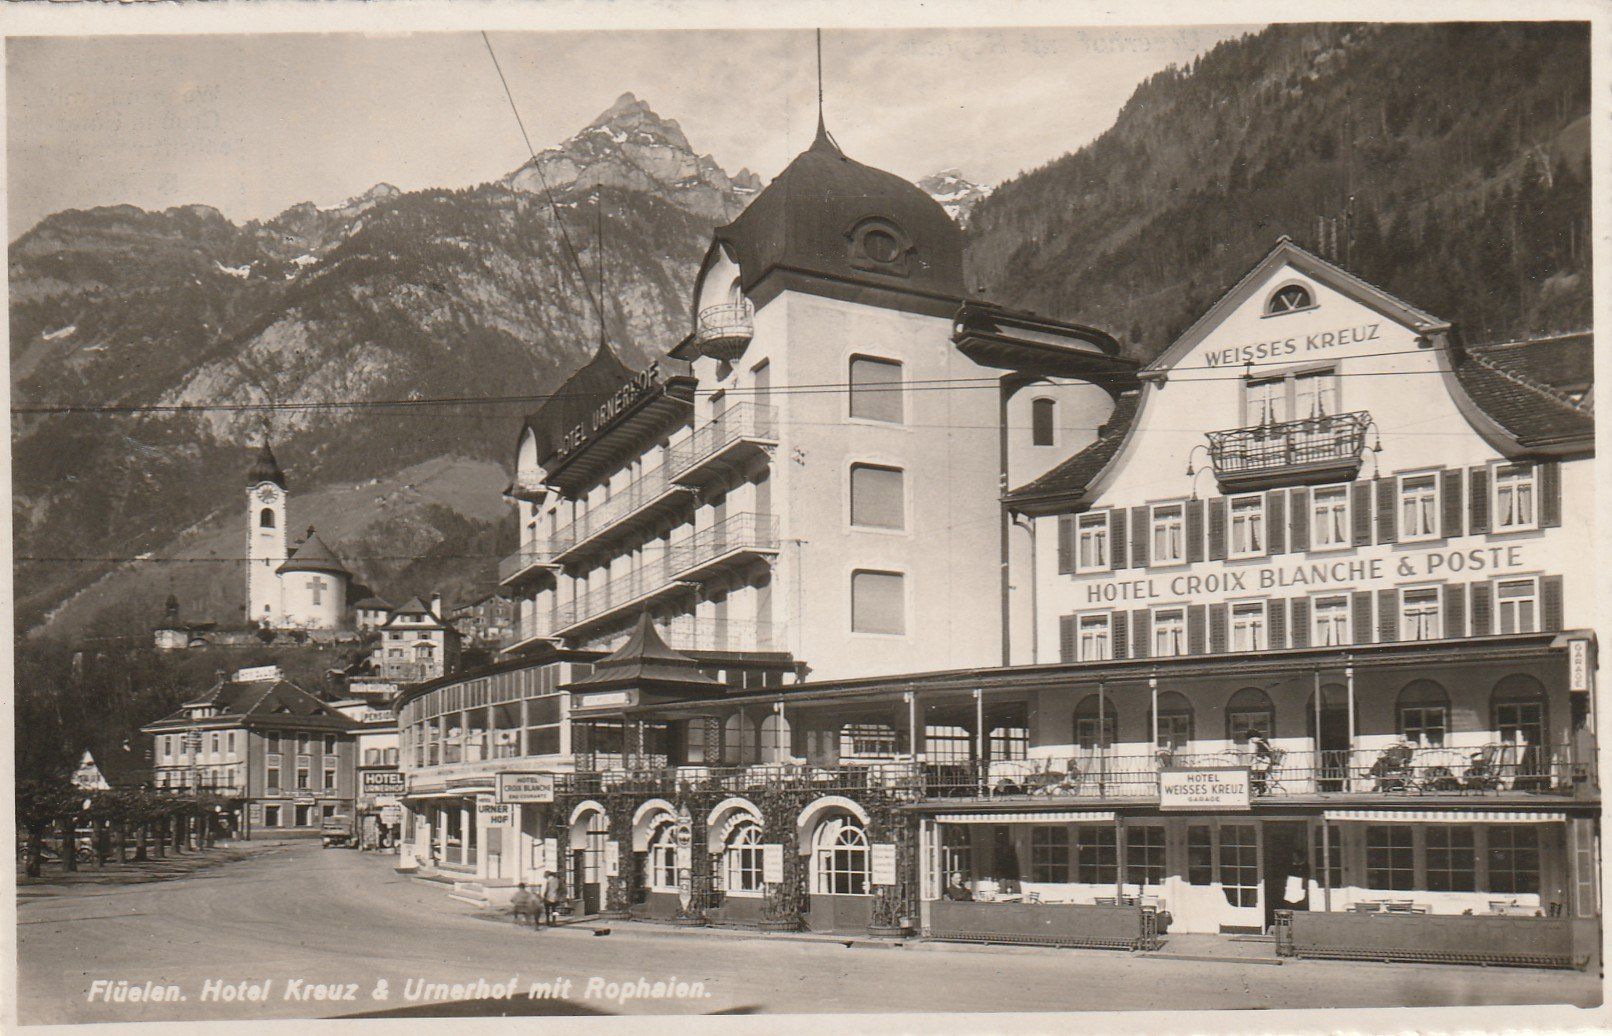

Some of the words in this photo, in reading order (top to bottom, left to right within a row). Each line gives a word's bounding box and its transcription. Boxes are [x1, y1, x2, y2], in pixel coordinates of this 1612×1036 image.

[1205, 338, 1296, 366] WEISSES
[1306, 324, 1380, 350] KREUZ
[592, 361, 659, 431] URNERHOF
[1087, 579, 1160, 602] HOTEL
[1171, 571, 1246, 596] CROIX
[1259, 561, 1383, 589] BLANCHE
[1396, 556, 1416, 577] &
[1427, 545, 1523, 574] POSTE
[1574, 643, 1582, 688] GARAGE
[365, 773, 404, 784] HOTEL
[1187, 774, 1220, 782] HOTEL
[364, 784, 404, 792] URNERHOF
[504, 784, 521, 792] CROIX
[524, 784, 551, 792] BLANCHE
[1165, 785, 1207, 795] WEISSES
[1212, 784, 1244, 794] KREUZ
[478, 805, 508, 813] URNER
[491, 815, 508, 824] HOF
